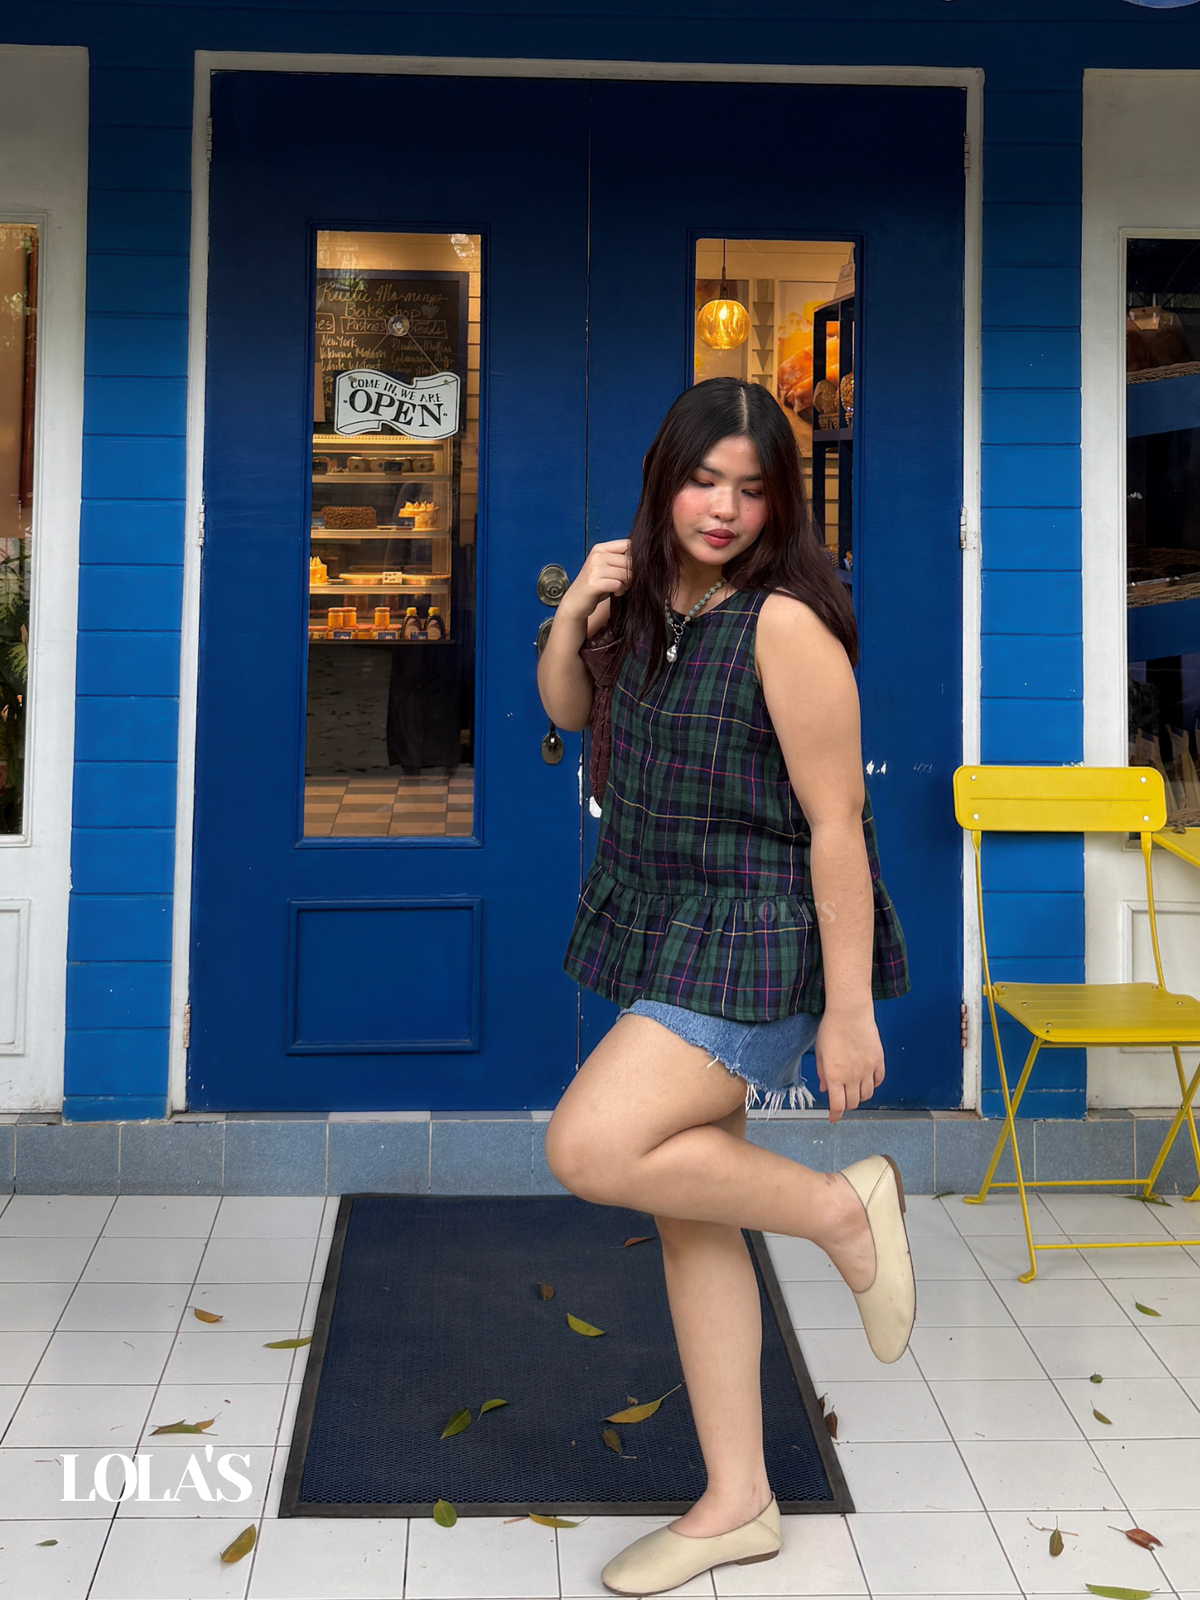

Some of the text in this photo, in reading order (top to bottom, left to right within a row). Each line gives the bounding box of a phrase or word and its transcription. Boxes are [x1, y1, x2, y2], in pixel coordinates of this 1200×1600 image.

[346, 318, 386, 332] Pastries
[408, 320, 445, 336] reads
[321, 334, 358, 348] New York
[350, 379, 442, 403] COME IN, WE ARE
[349, 388, 444, 427] OPEN
